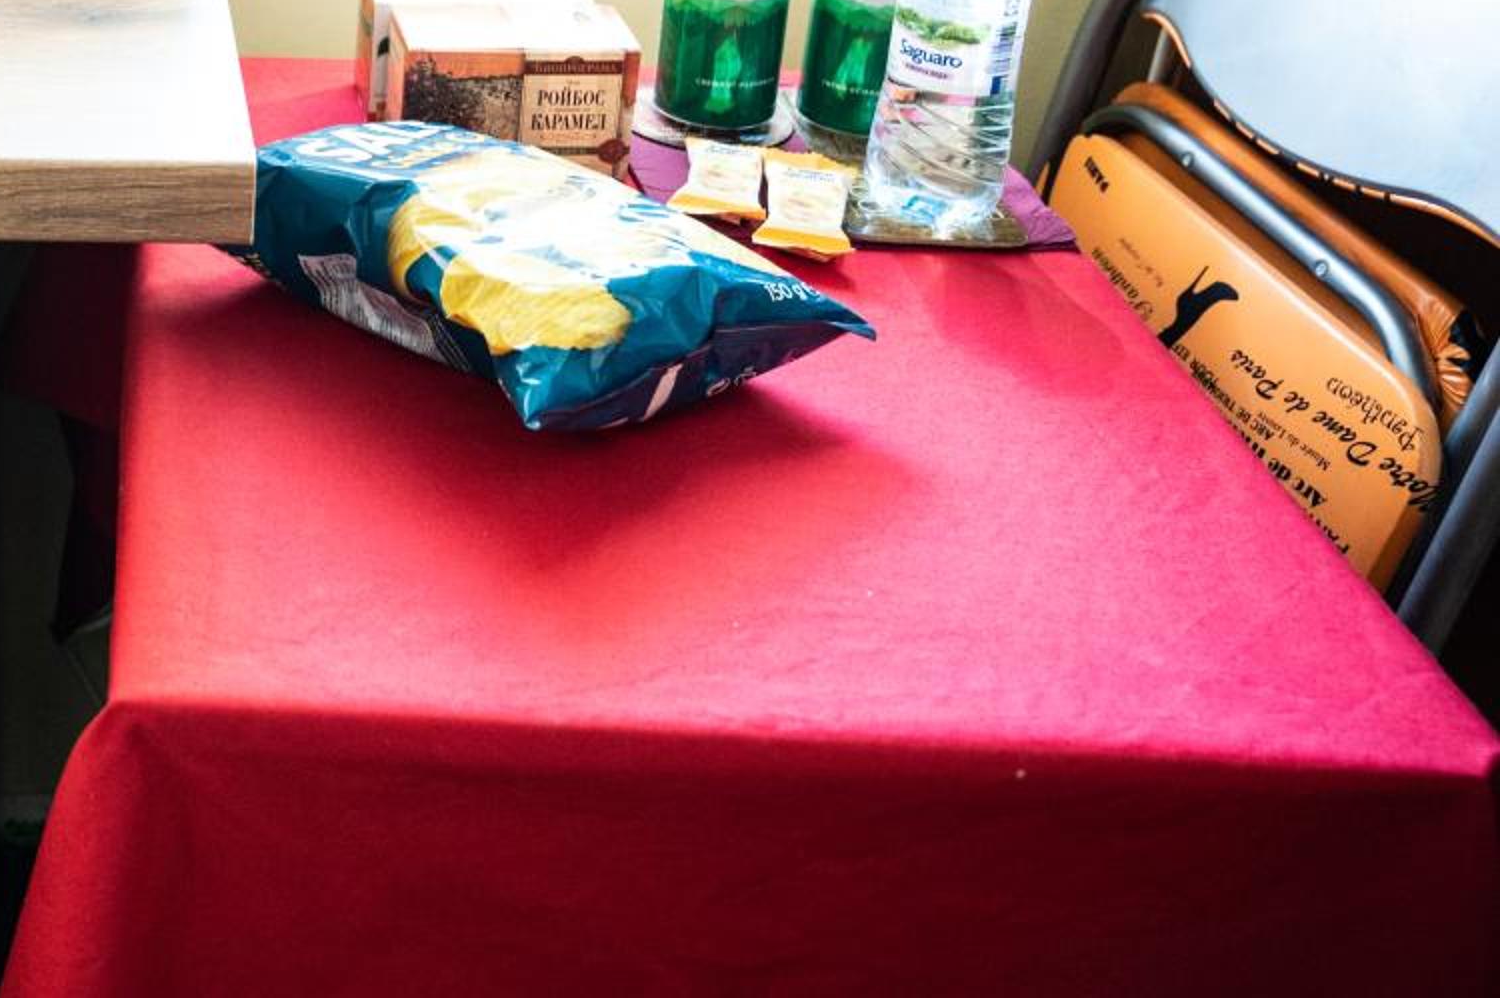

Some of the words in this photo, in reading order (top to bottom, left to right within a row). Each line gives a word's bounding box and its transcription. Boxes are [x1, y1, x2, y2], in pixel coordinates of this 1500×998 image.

[900, 39, 963, 68] Saguaro
[537, 86, 606, 107] РОЙБОС
[531, 113, 607, 131] КАРАМЕЛ
[764, 282, 793, 302] 150
[1230, 349, 1285, 401] Paris
[1284, 391, 1311, 414] de
[1311, 410, 1378, 467] Dame
[1292, 477, 1328, 508] Arc
